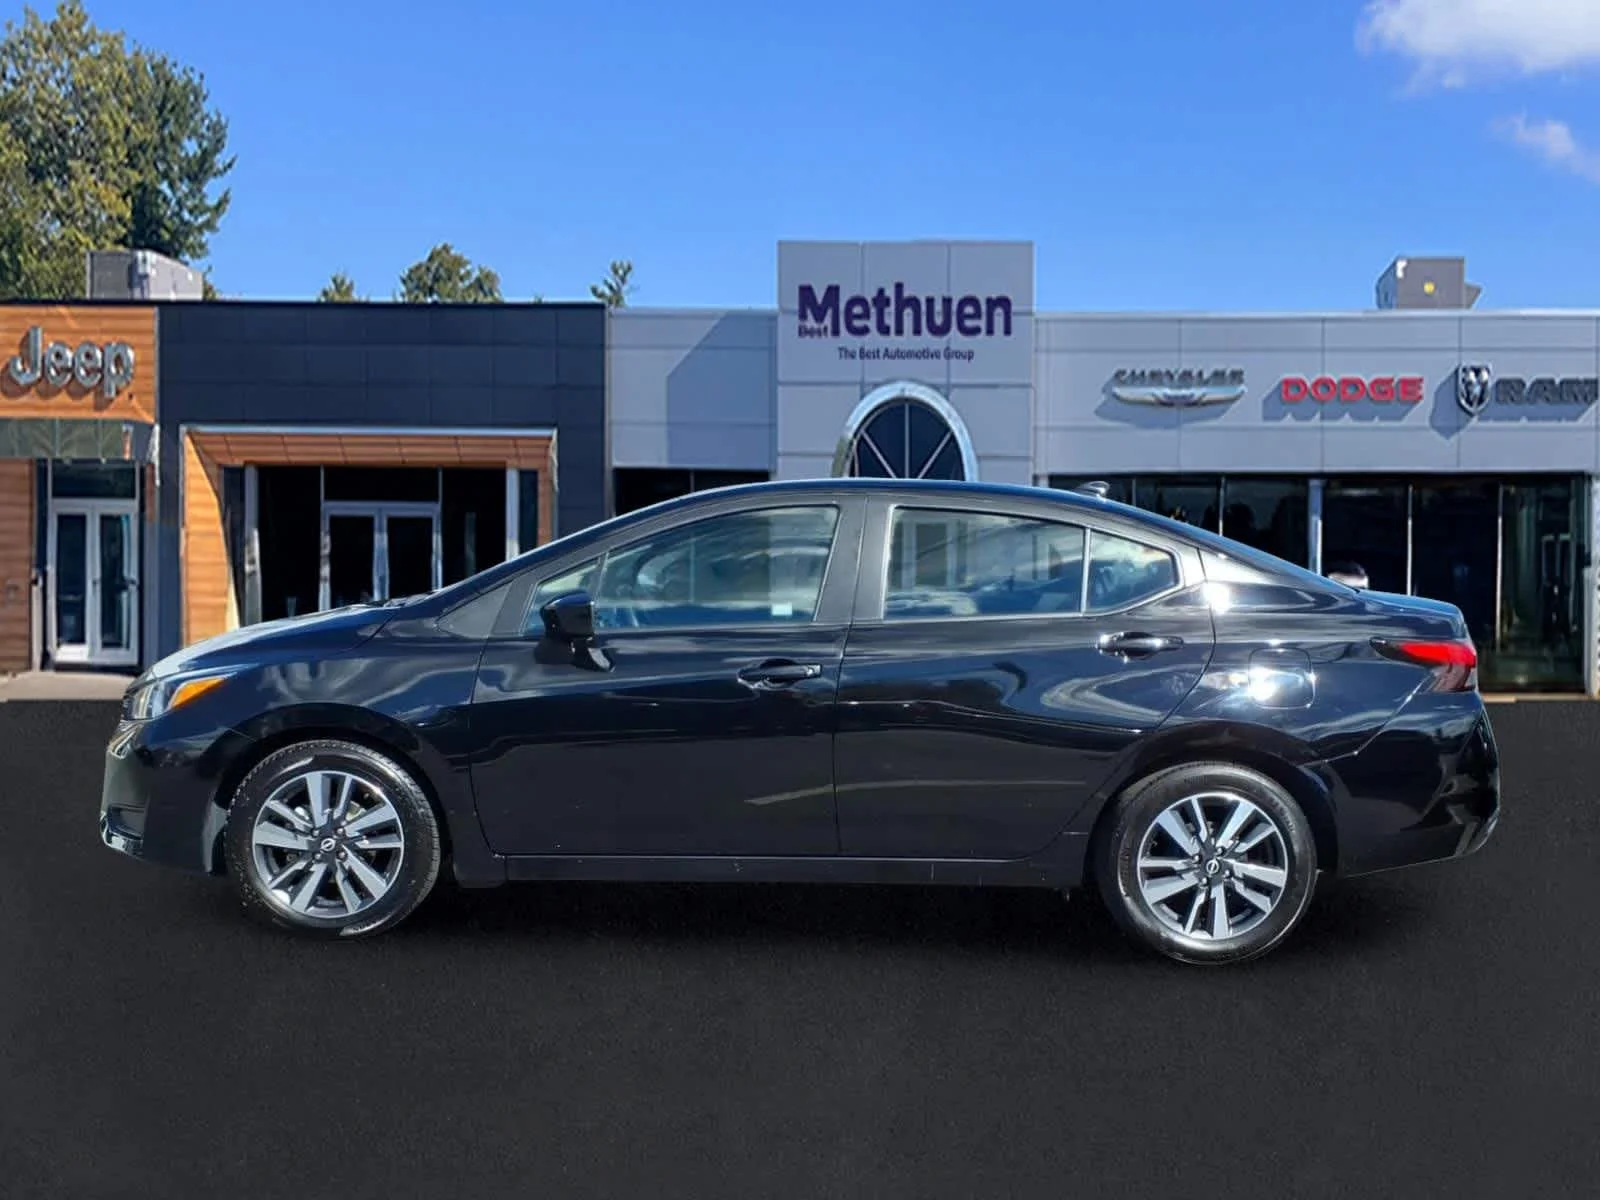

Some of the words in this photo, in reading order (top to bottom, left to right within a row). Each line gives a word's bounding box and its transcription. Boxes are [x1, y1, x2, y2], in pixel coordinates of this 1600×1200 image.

[798, 281, 1012, 337] Methuen
[9, 325, 134, 398] Jeep
[838, 347, 857, 361] The
[859, 347, 881, 361] Best
[883, 347, 941, 361] Automotive
[943, 346, 975, 363] Group
[1281, 377, 1424, 402] DODGE
[1495, 378, 1598, 405] RAM
